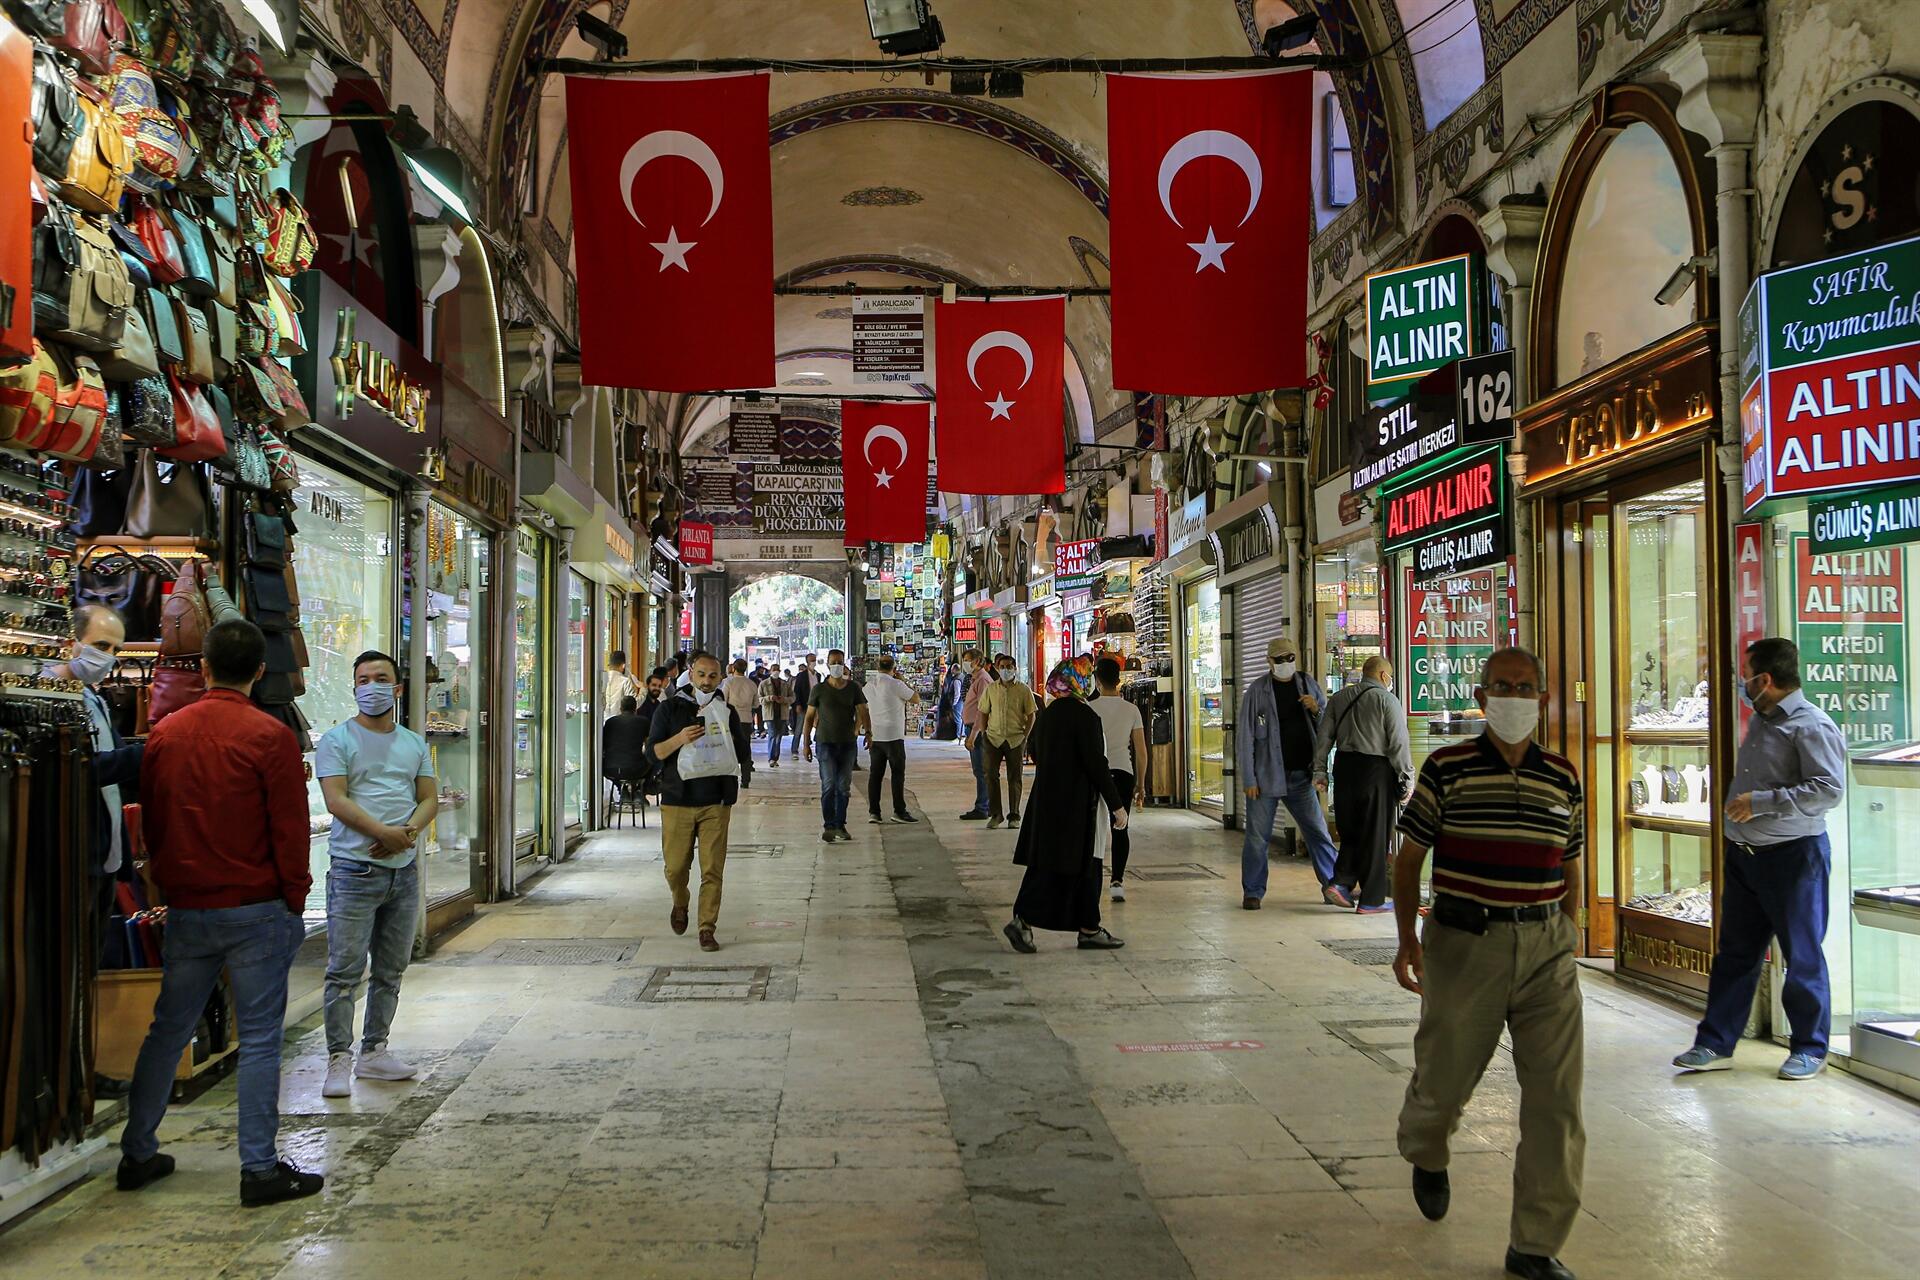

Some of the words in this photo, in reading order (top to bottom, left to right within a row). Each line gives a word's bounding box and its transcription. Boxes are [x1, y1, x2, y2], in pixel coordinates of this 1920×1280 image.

[1831, 166, 1865, 230] S
[1808, 258, 1894, 305] SAFİR
[1380, 273, 1456, 320] ALTIN
[1374, 321, 1464, 370] ALINIR
[1463, 370, 1512, 425] 162
[1787, 361, 1920, 422] ALTIN
[1378, 403, 1417, 446] STIL
[1353, 466, 1371, 490] ALTIN
[1386, 452, 1396, 473] VE
[1396, 441, 1418, 468] SATIM
[1418, 419, 1456, 458] MERKEZİ
[311, 491, 343, 523] AYDIN
[771, 493, 844, 507] RENGARENK
[1388, 486, 1431, 538] ALTIN
[1434, 463, 1493, 523] ALINIR
[682, 528, 711, 545] PIRLANTA
[765, 516, 846, 533] HOŞGELDİNİZ
[1814, 501, 1872, 543] GÜMÜŞ
[684, 547, 707, 559] ALINIR
[1420, 537, 1455, 571] GÜMÜŞ
[1456, 529, 1494, 561] ALINIR
[1811, 550, 1890, 576] ALTIN
[1412, 579, 1440, 591] HER
[1804, 586, 1899, 613] ALINIR
[1420, 596, 1482, 613] ALTIN
[1414, 620, 1489, 638] ALINIR
[1821, 632, 1885, 654] KREDİ
[1806, 663, 1898, 682] KARTINA
[1816, 689, 1890, 712] TAKSİT
